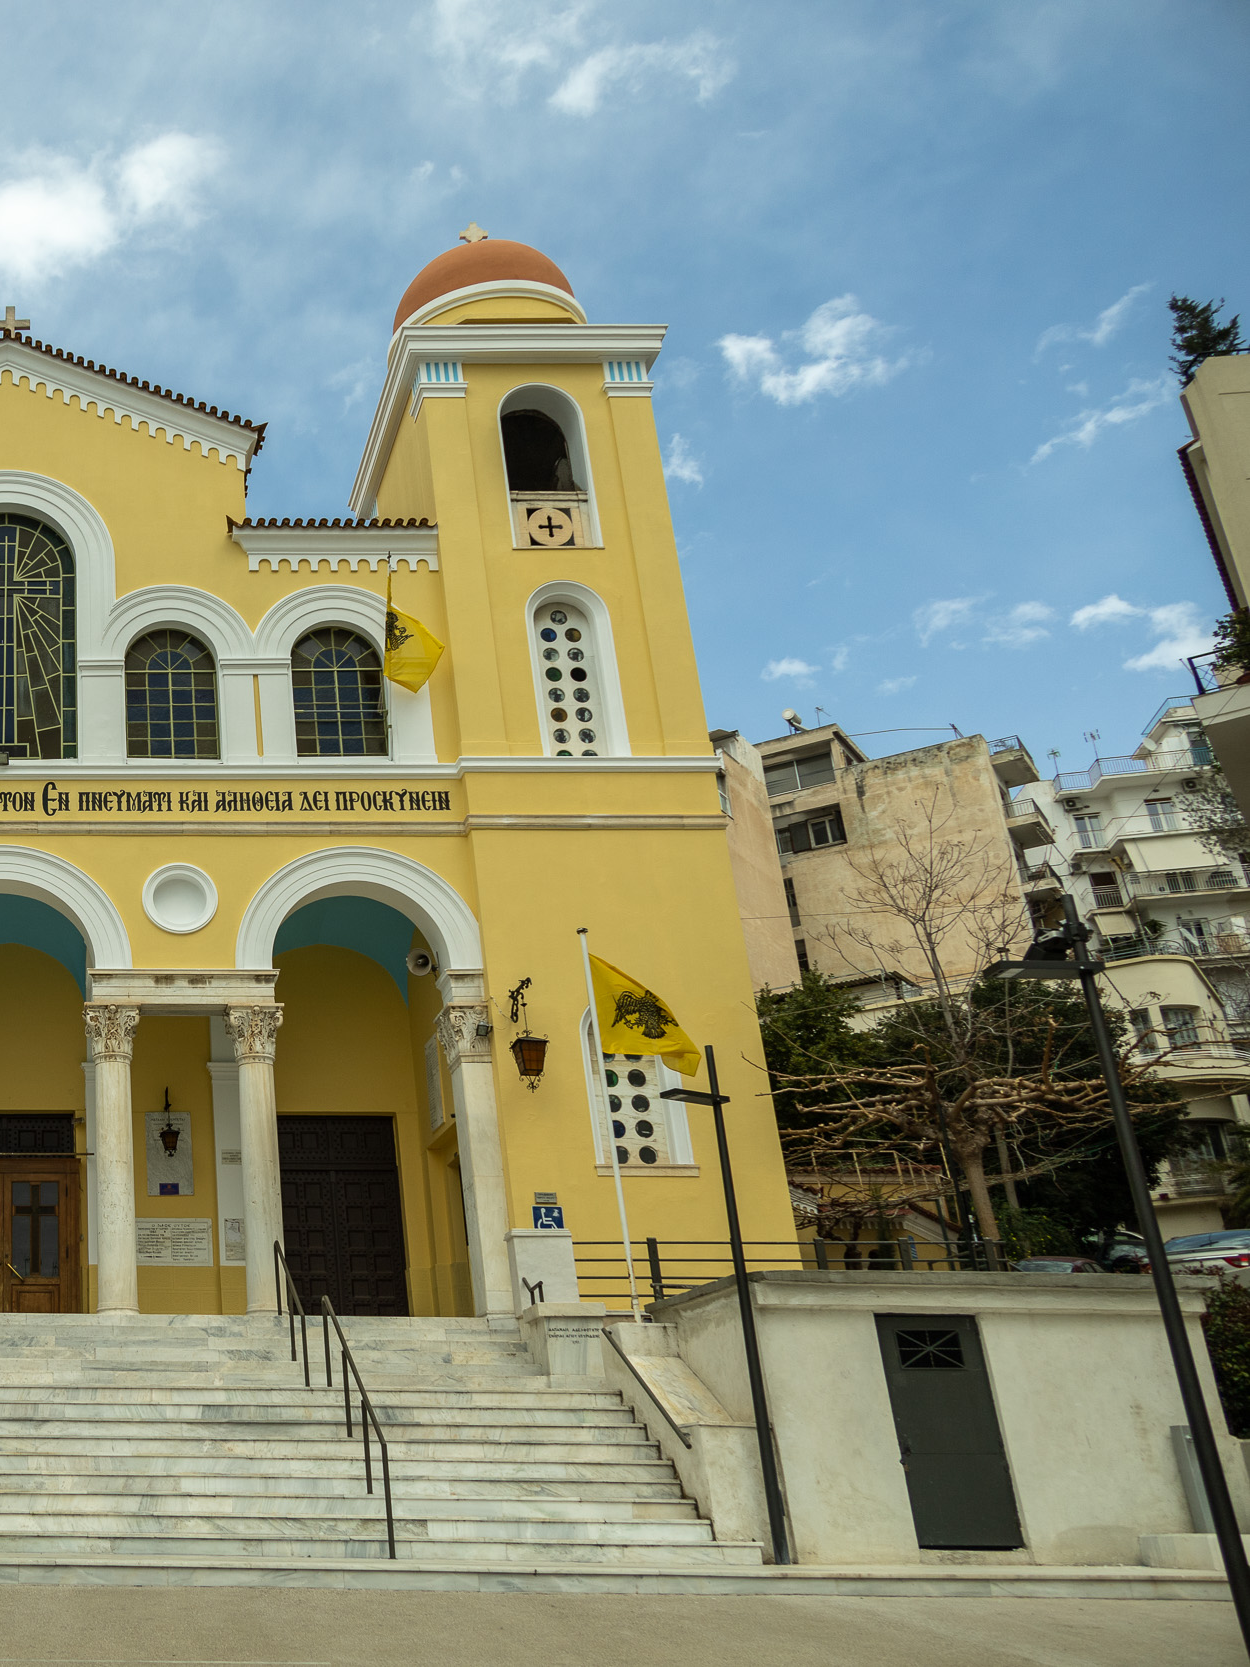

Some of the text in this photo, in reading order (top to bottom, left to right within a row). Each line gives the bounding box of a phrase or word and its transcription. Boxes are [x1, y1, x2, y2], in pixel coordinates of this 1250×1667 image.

[78, 789, 173, 813] ΠΝΕΥΜΑΤΙ
[179, 790, 209, 813] ΚΑΙ
[299, 790, 330, 812] ΔΕΙ
